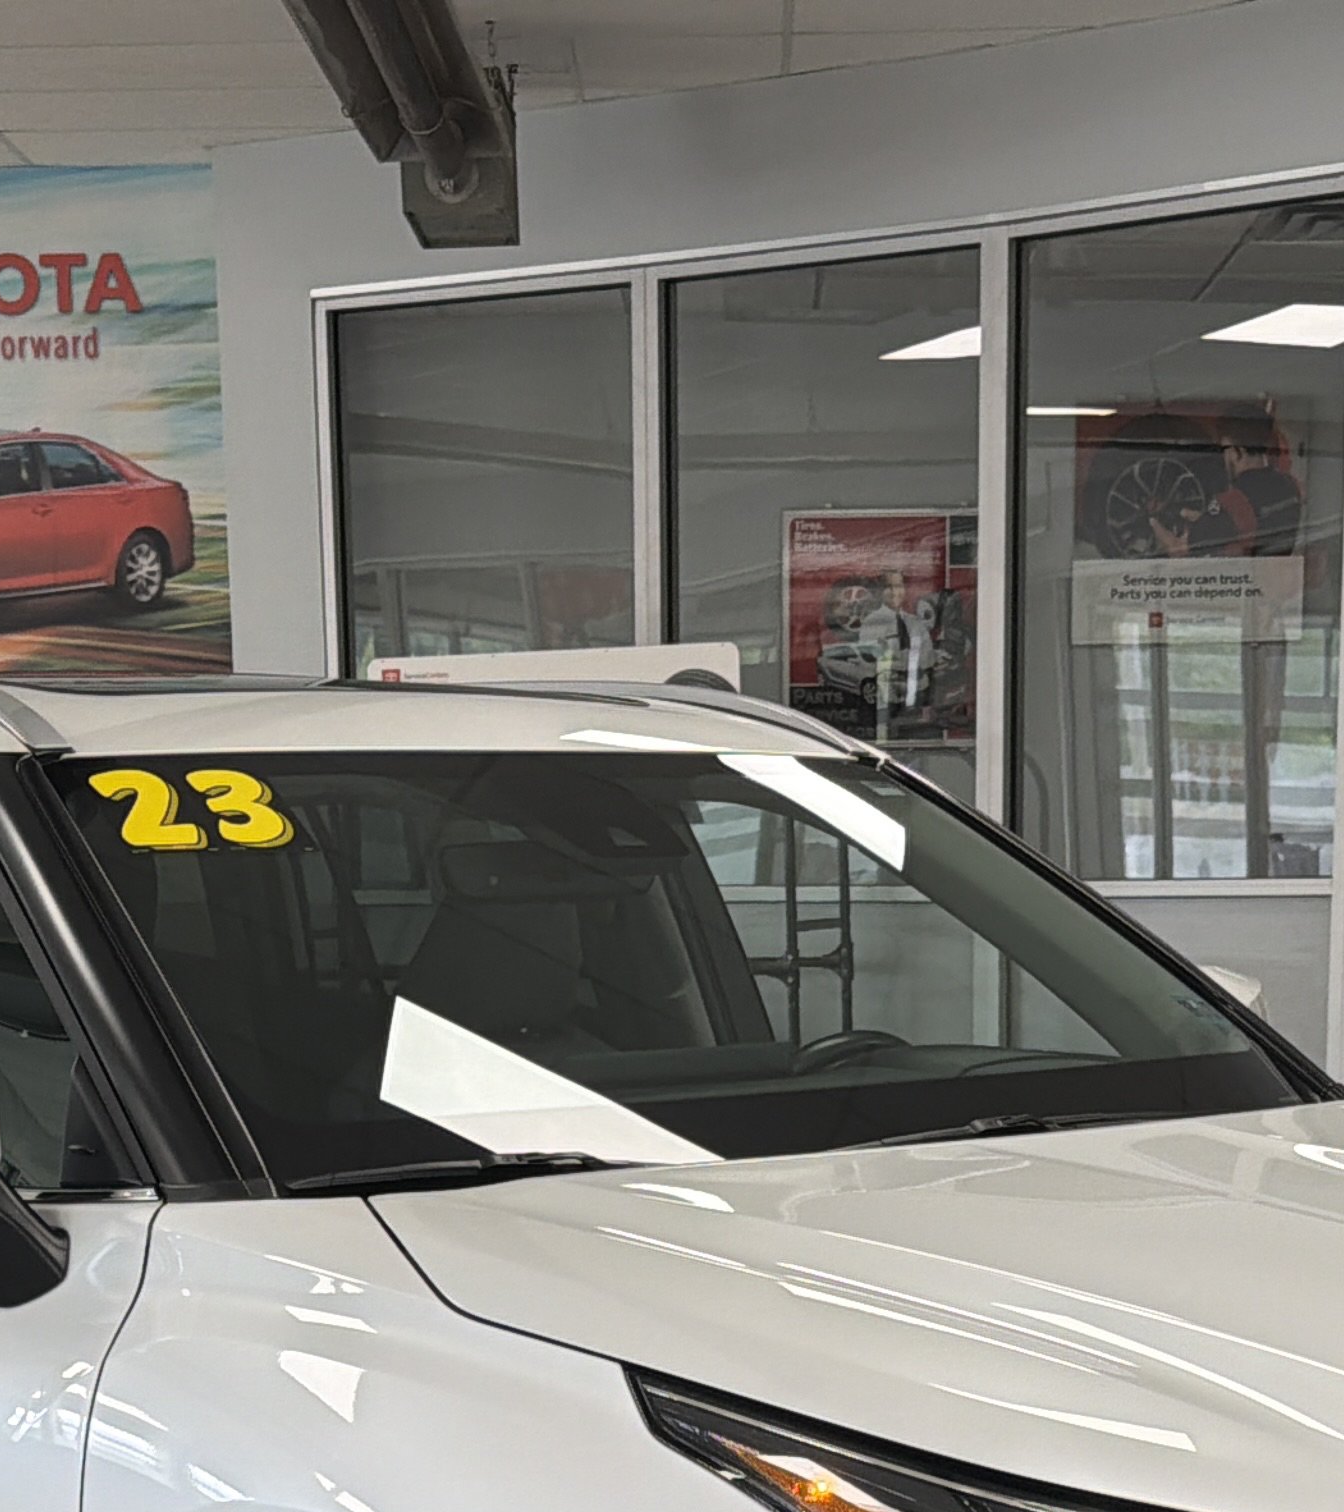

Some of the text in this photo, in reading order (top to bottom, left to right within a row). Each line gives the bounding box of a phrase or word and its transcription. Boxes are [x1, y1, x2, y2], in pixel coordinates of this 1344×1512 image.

[1123, 574, 1253, 587] Service you can trust.
[1111, 588, 1141, 599] Parts
[1145, 589, 1167, 601] you
[1170, 589, 1192, 598] can
[1195, 587, 1242, 600] depend
[88, 769, 296, 851] 23
